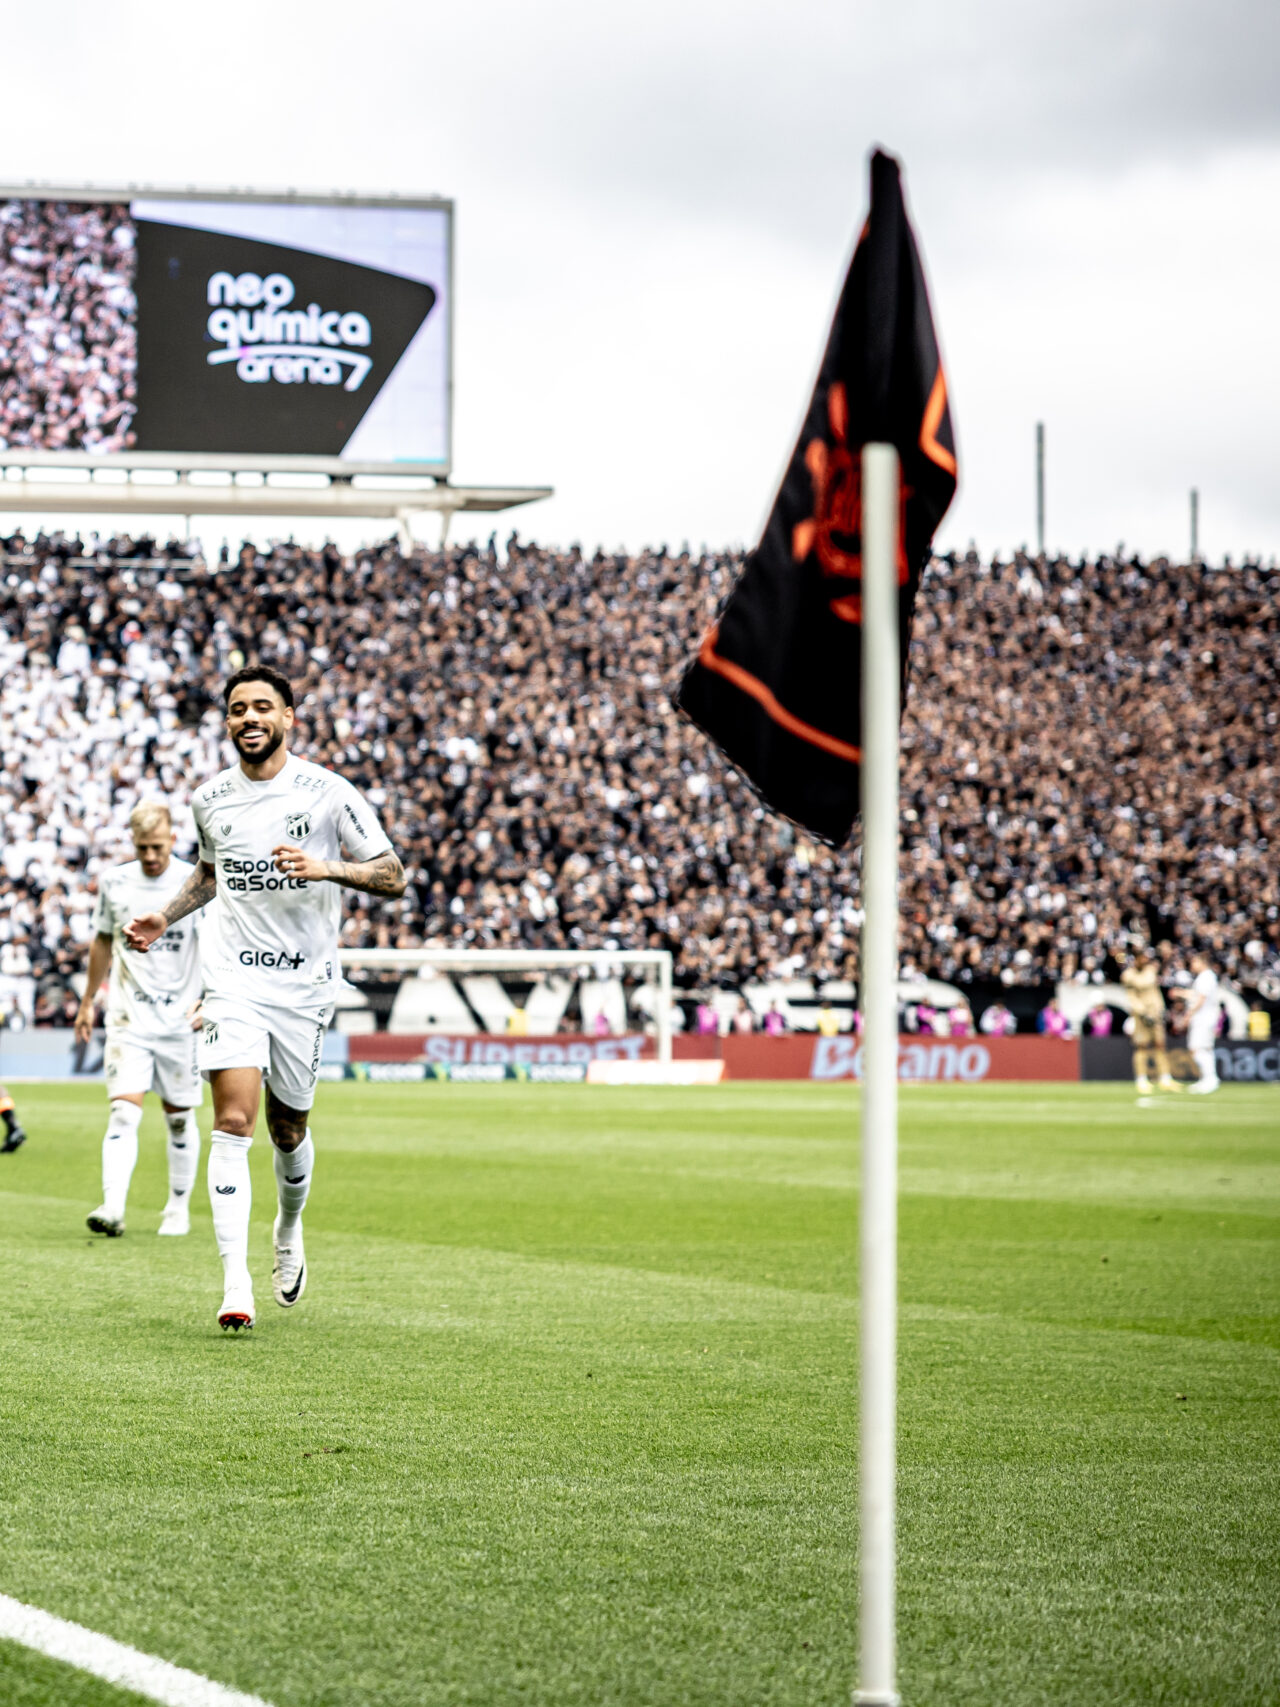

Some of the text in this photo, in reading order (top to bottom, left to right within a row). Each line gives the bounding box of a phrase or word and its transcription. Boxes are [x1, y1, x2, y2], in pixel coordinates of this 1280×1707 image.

[206, 271, 295, 307] neo
[236, 357, 343, 385] arena
[223, 858, 276, 876] Espor
[811, 1036, 991, 1081] Bano
